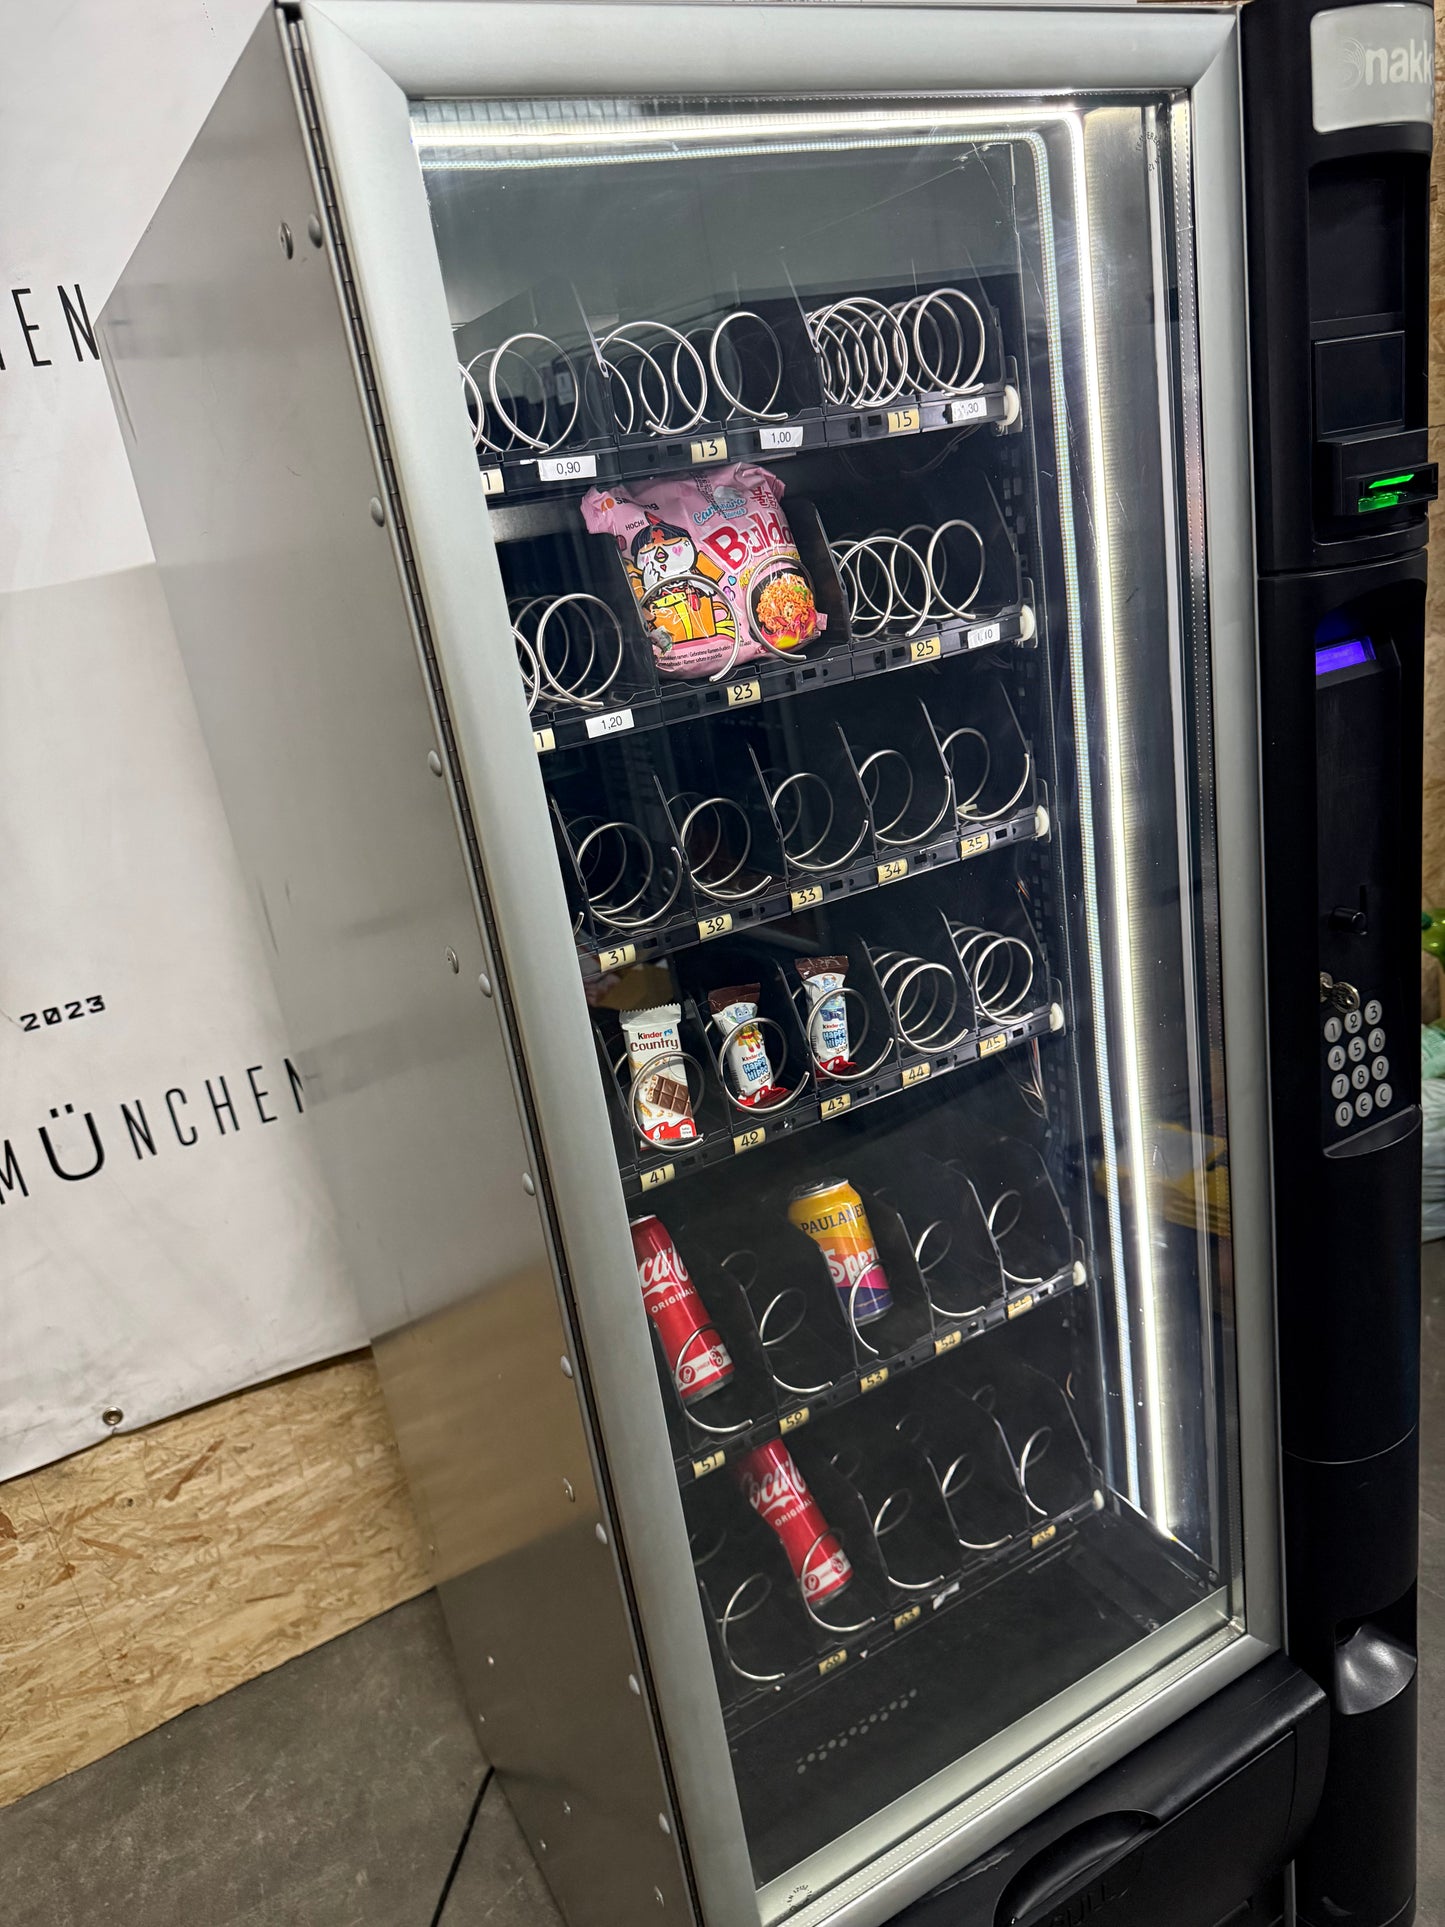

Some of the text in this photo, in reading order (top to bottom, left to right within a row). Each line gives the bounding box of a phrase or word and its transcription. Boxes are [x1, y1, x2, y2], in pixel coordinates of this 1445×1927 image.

[0, 284, 100, 370] EN
[894, 411, 912, 428] 15
[771, 431, 791, 445] 1,00
[697, 440, 718, 458] 13
[556, 461, 581, 476] 0,90
[916, 640, 934, 657] 25
[733, 682, 753, 701] 23
[601, 715, 623, 731] 1,20
[967, 836, 982, 853] 35
[884, 861, 902, 879] 34
[798, 888, 816, 905] 33
[705, 916, 725, 935] 32
[608, 948, 627, 966] 31
[19, 994, 106, 1032] 2023
[1350, 1013, 1357, 1028] 2
[1370, 1006, 1378, 1021] 3
[1330, 1022, 1337, 1036] 1
[630, 1037, 679, 1053] Country
[986, 1035, 1001, 1049] 45
[1374, 1033, 1381, 1047] 6
[1354, 1042, 1361, 1056] 5
[1333, 1051, 1341, 1065] 4
[908, 1066, 925, 1081] 44
[1377, 1061, 1384, 1075] 9
[1357, 1070, 1365, 1084] 8
[1337, 1079, 1344, 1093] 7
[1379, 1088, 1387, 1102] C
[827, 1096, 845, 1112] 43
[1341, 1107, 1348, 1121] 0
[740, 1131, 759, 1147] 42
[649, 1168, 666, 1184] 41
[800, 1203, 864, 1234] PAULANE
[651, 1288, 694, 1313] ORIGINAL
[774, 1498, 812, 1526] ORIGINAL
